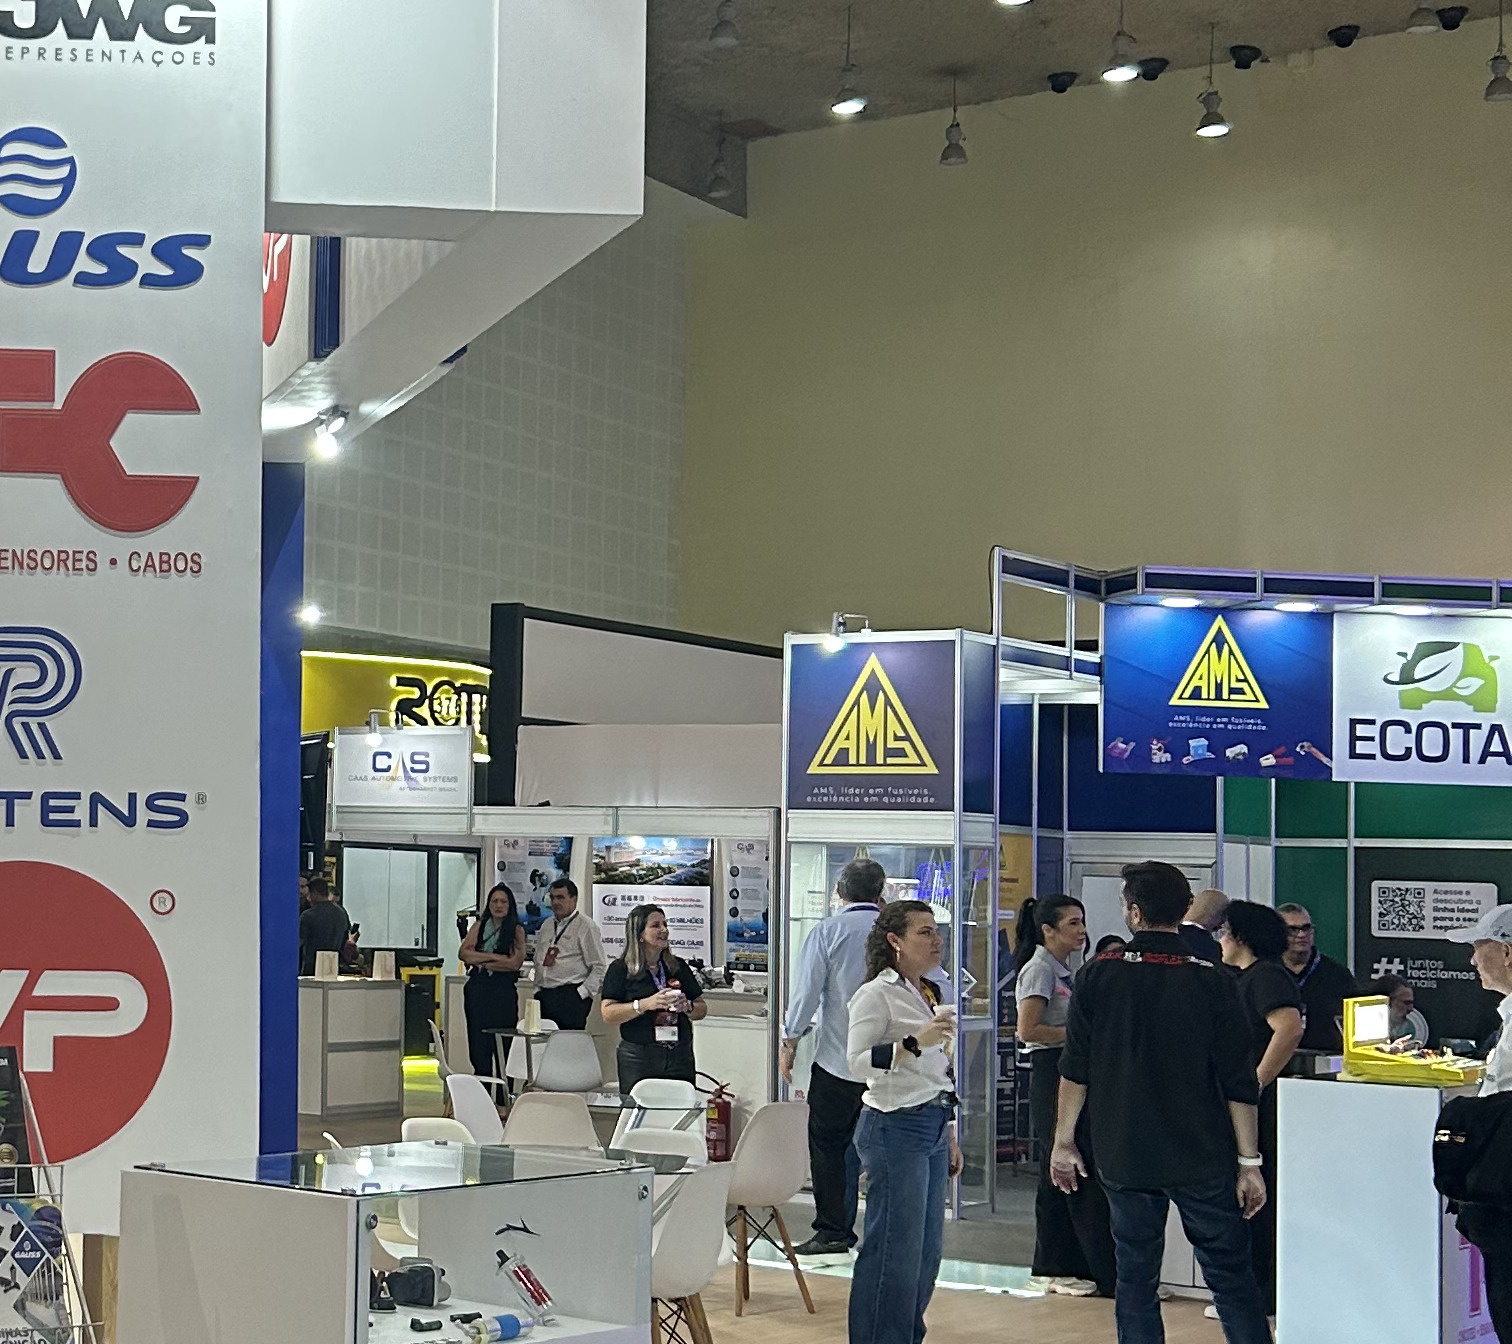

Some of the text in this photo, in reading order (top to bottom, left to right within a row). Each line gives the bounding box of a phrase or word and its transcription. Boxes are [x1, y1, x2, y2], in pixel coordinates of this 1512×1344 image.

[127, 550, 203, 575] CABOS
[1181, 641, 1257, 701] AMS
[822, 689, 922, 765] AMS
[423, 774, 459, 784] SYSTEMS
[1433, 888, 1463, 896] Acesse
[1432, 897, 1474, 905] descubra
[1457, 906, 1479, 914] ideal
[1433, 916, 1454, 924] para
[1406, 957, 1445, 970] juntos
[1406, 967, 1476, 981] reciclamos
[1407, 978, 1438, 989] mais
[14, 1250, 42, 1259] GAUSS
